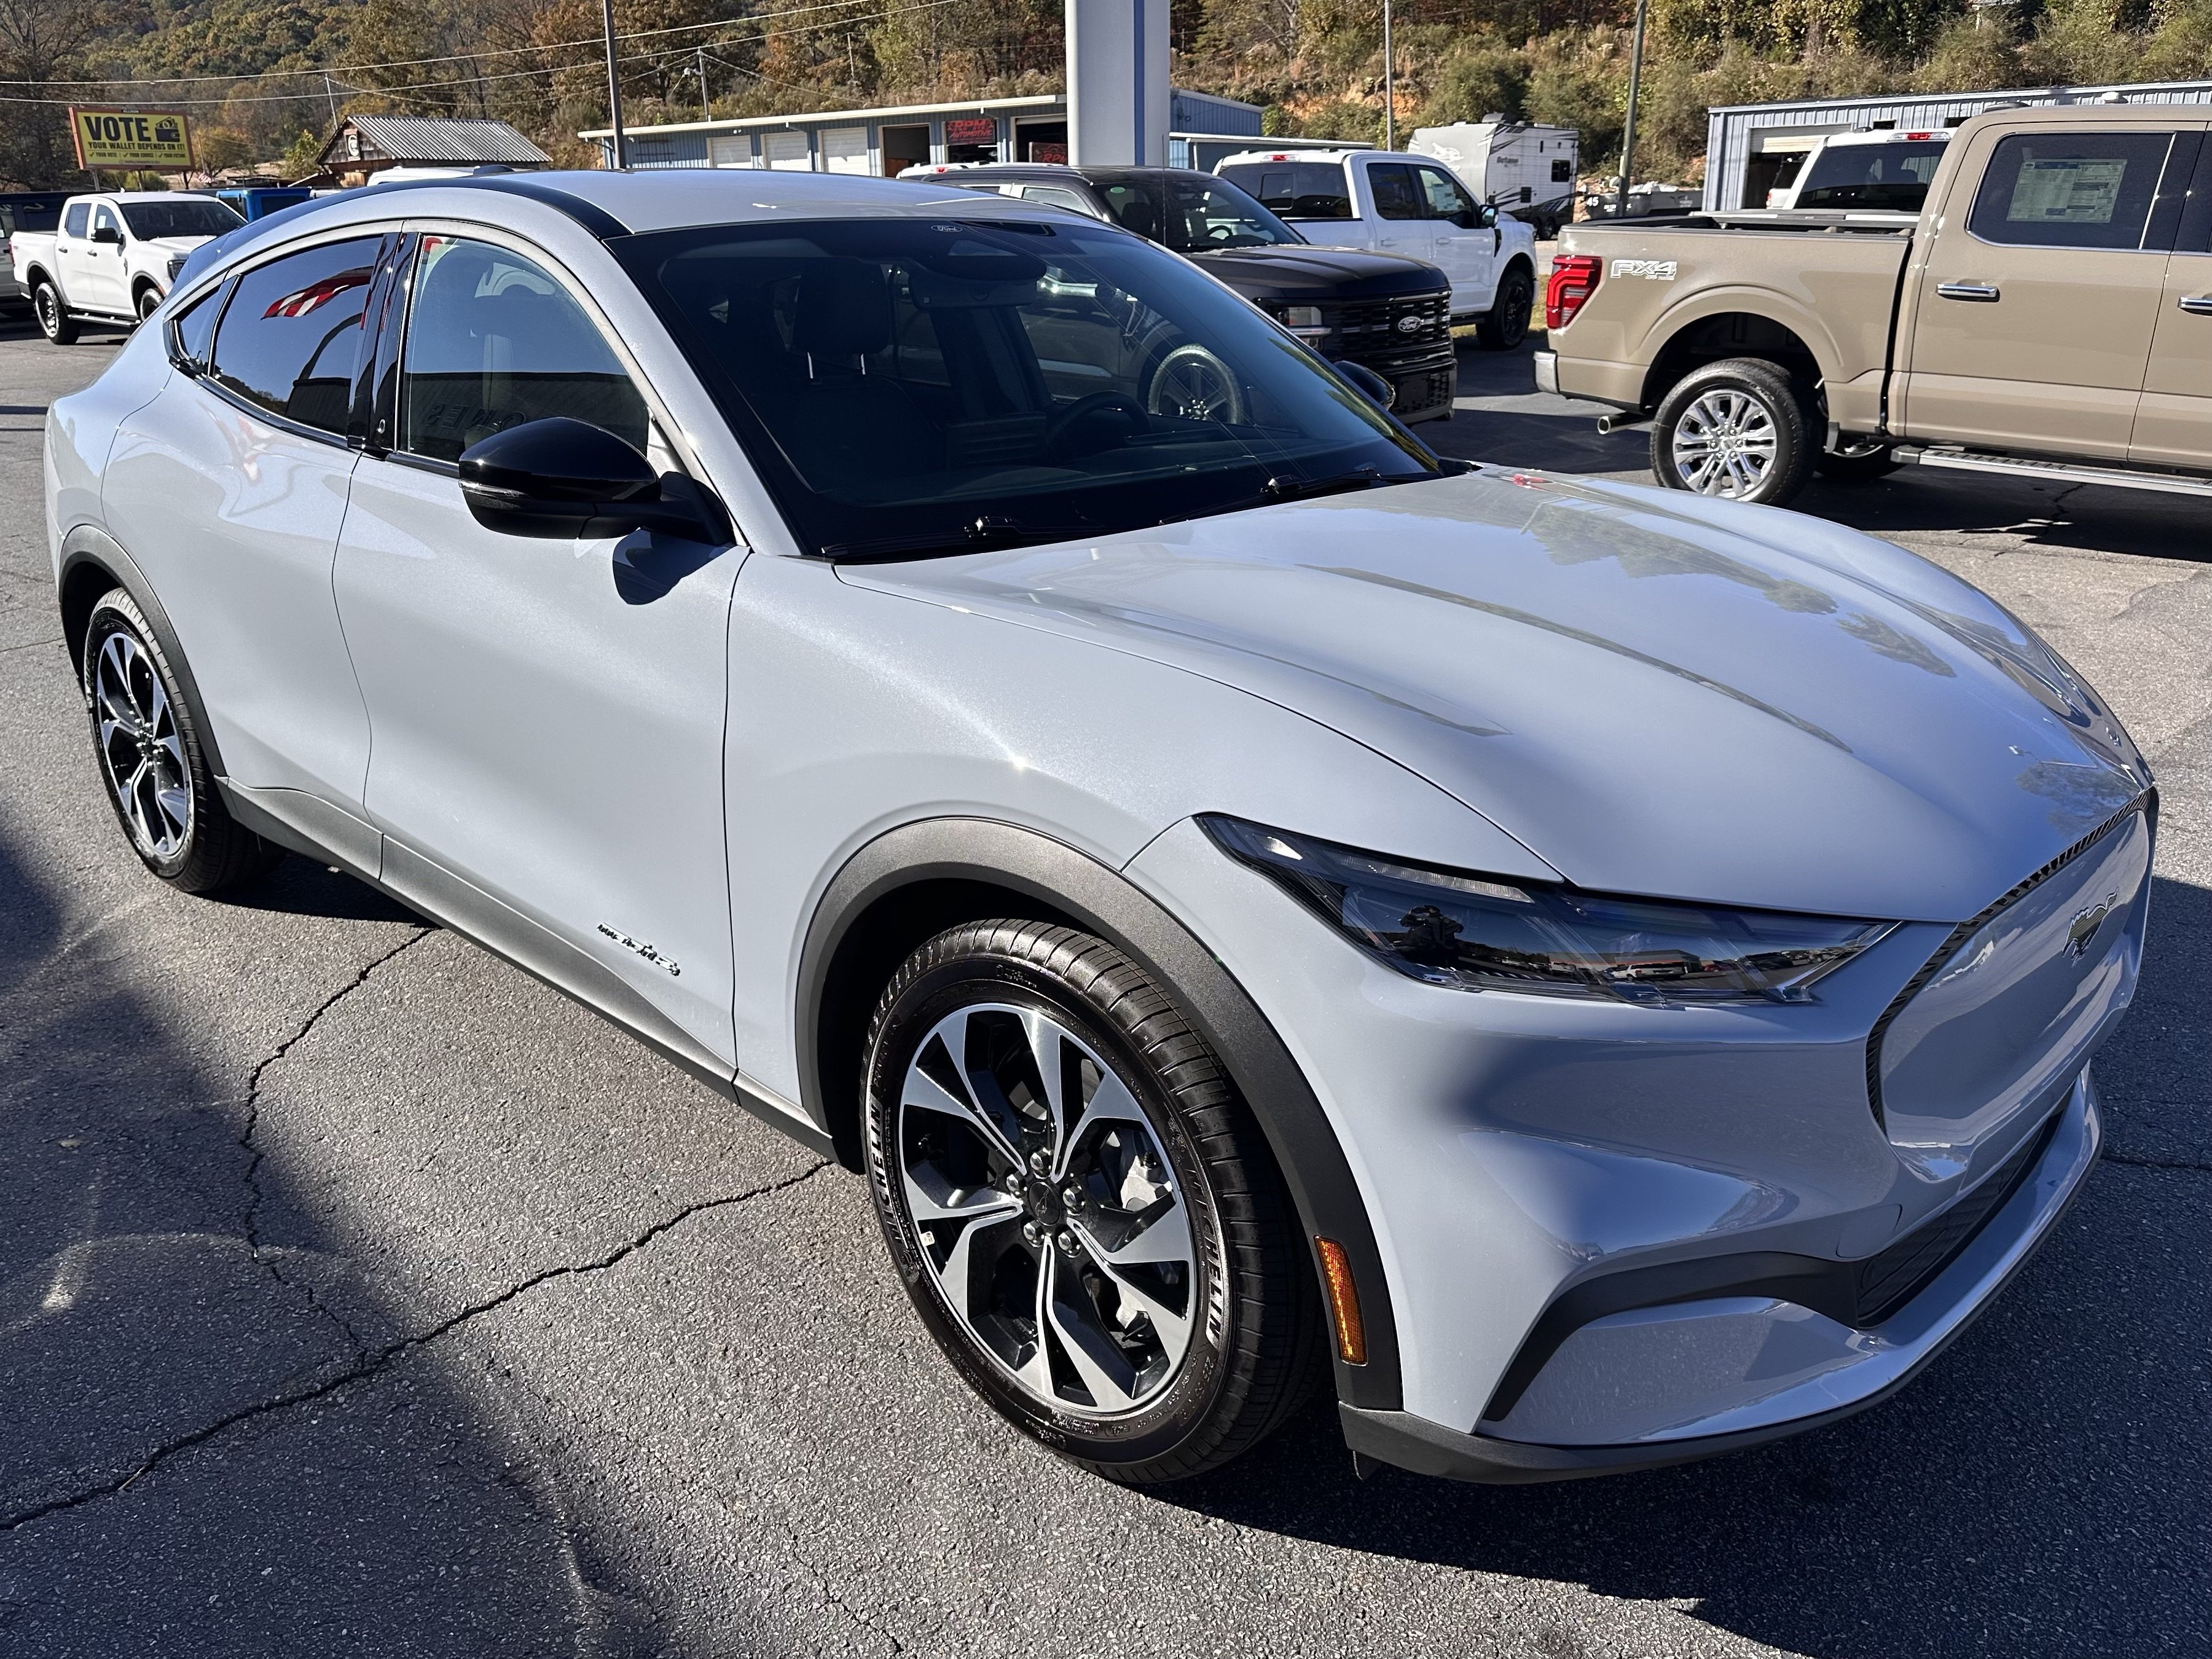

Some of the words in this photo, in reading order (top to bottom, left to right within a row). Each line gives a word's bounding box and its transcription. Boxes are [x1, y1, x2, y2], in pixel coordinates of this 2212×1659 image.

[84, 116, 151, 141] VOTE
[954, 119, 986, 131] RPM
[949, 129, 992, 138] AUTOMOTIVE
[1586, 196, 1599, 206] 45
[1610, 260, 1677, 278] FX4
[1400, 318, 1420, 331] Ford
[869, 1103, 908, 1250] MICHELIN
[1183, 1167, 1222, 1339] MICHELIN
